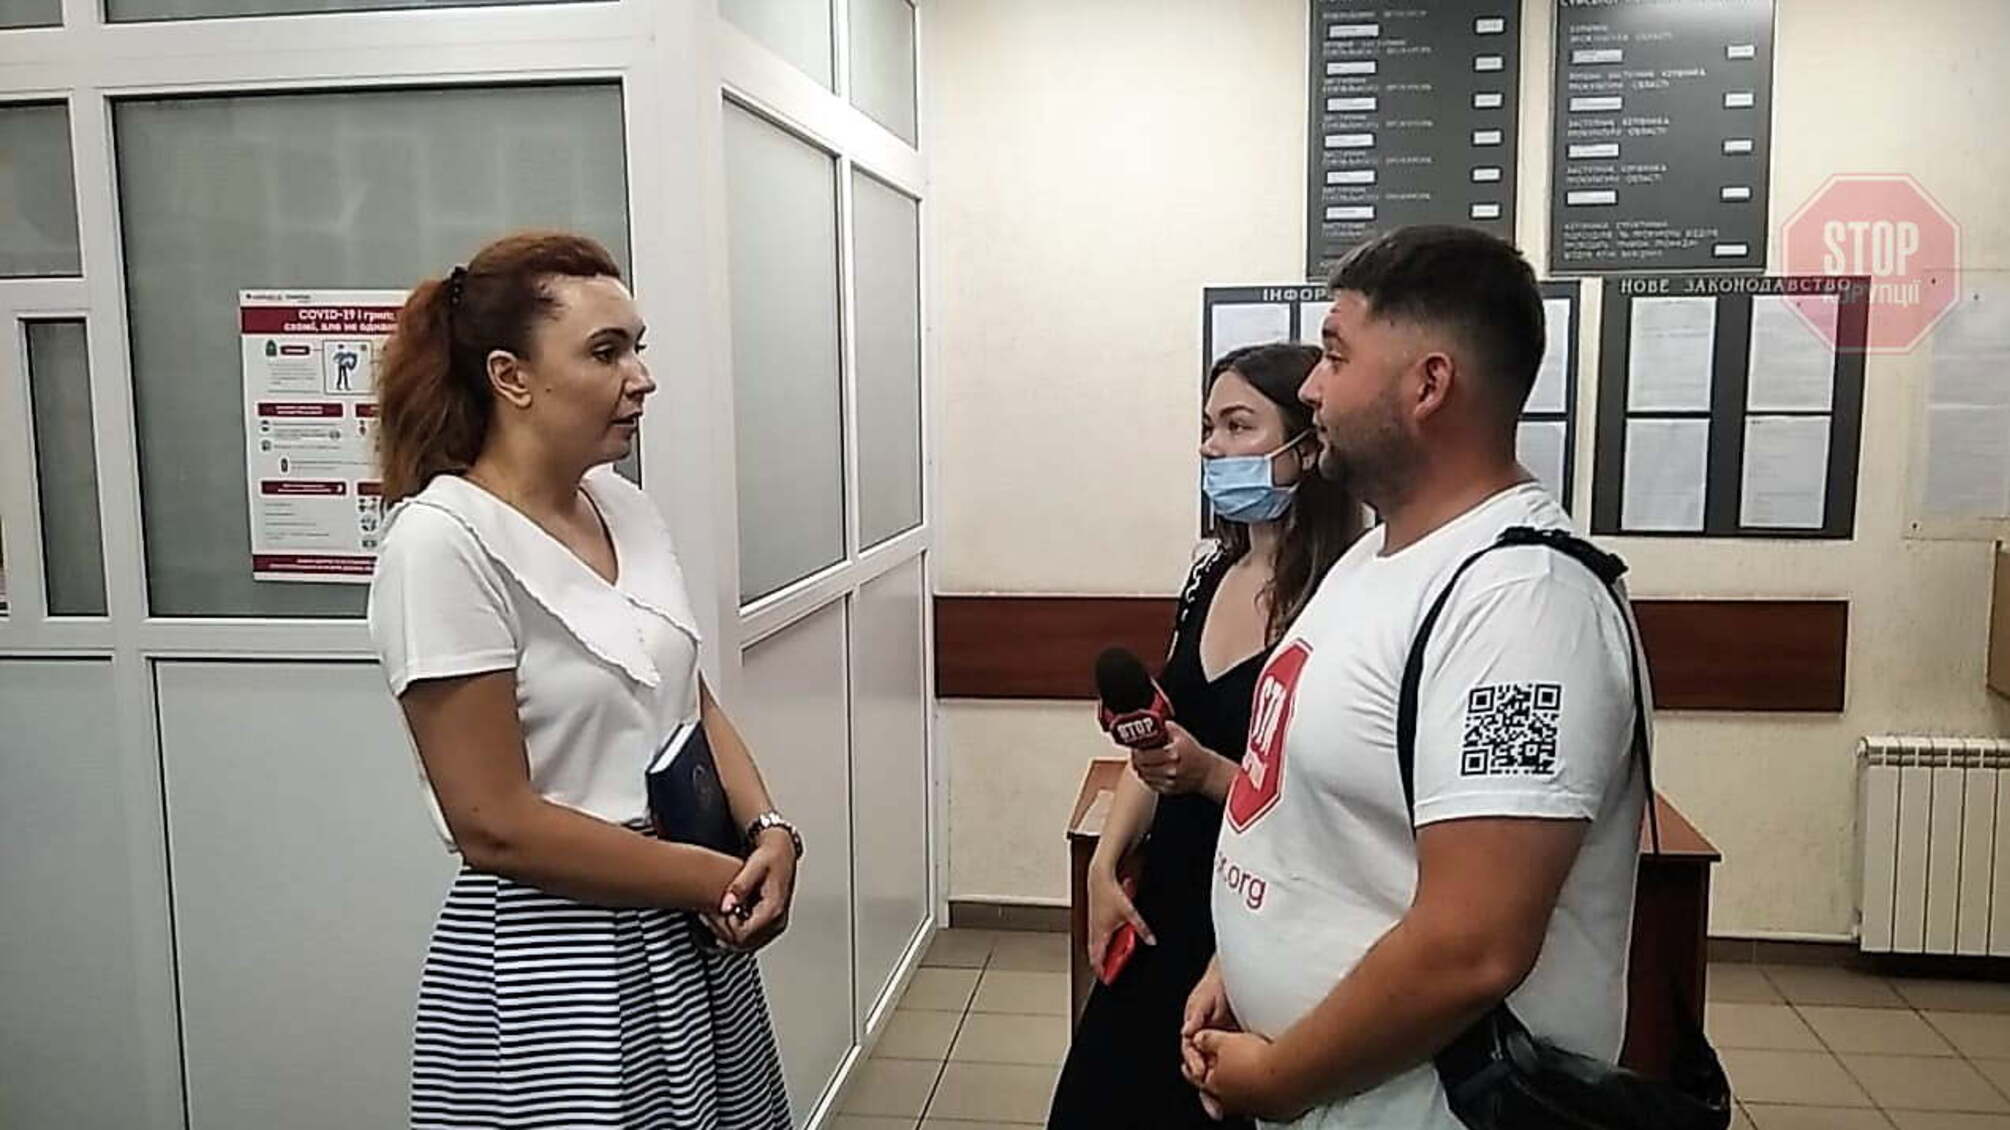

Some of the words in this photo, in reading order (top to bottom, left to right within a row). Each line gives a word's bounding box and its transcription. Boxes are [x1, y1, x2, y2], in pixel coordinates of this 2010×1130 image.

[1621, 278, 1669, 293] НОВЕ
[1684, 278, 1851, 294] ЗАКОНОДАВСТВО
[298, 309, 356, 320] COVID-19
[1117, 717, 1154, 740] STOP
